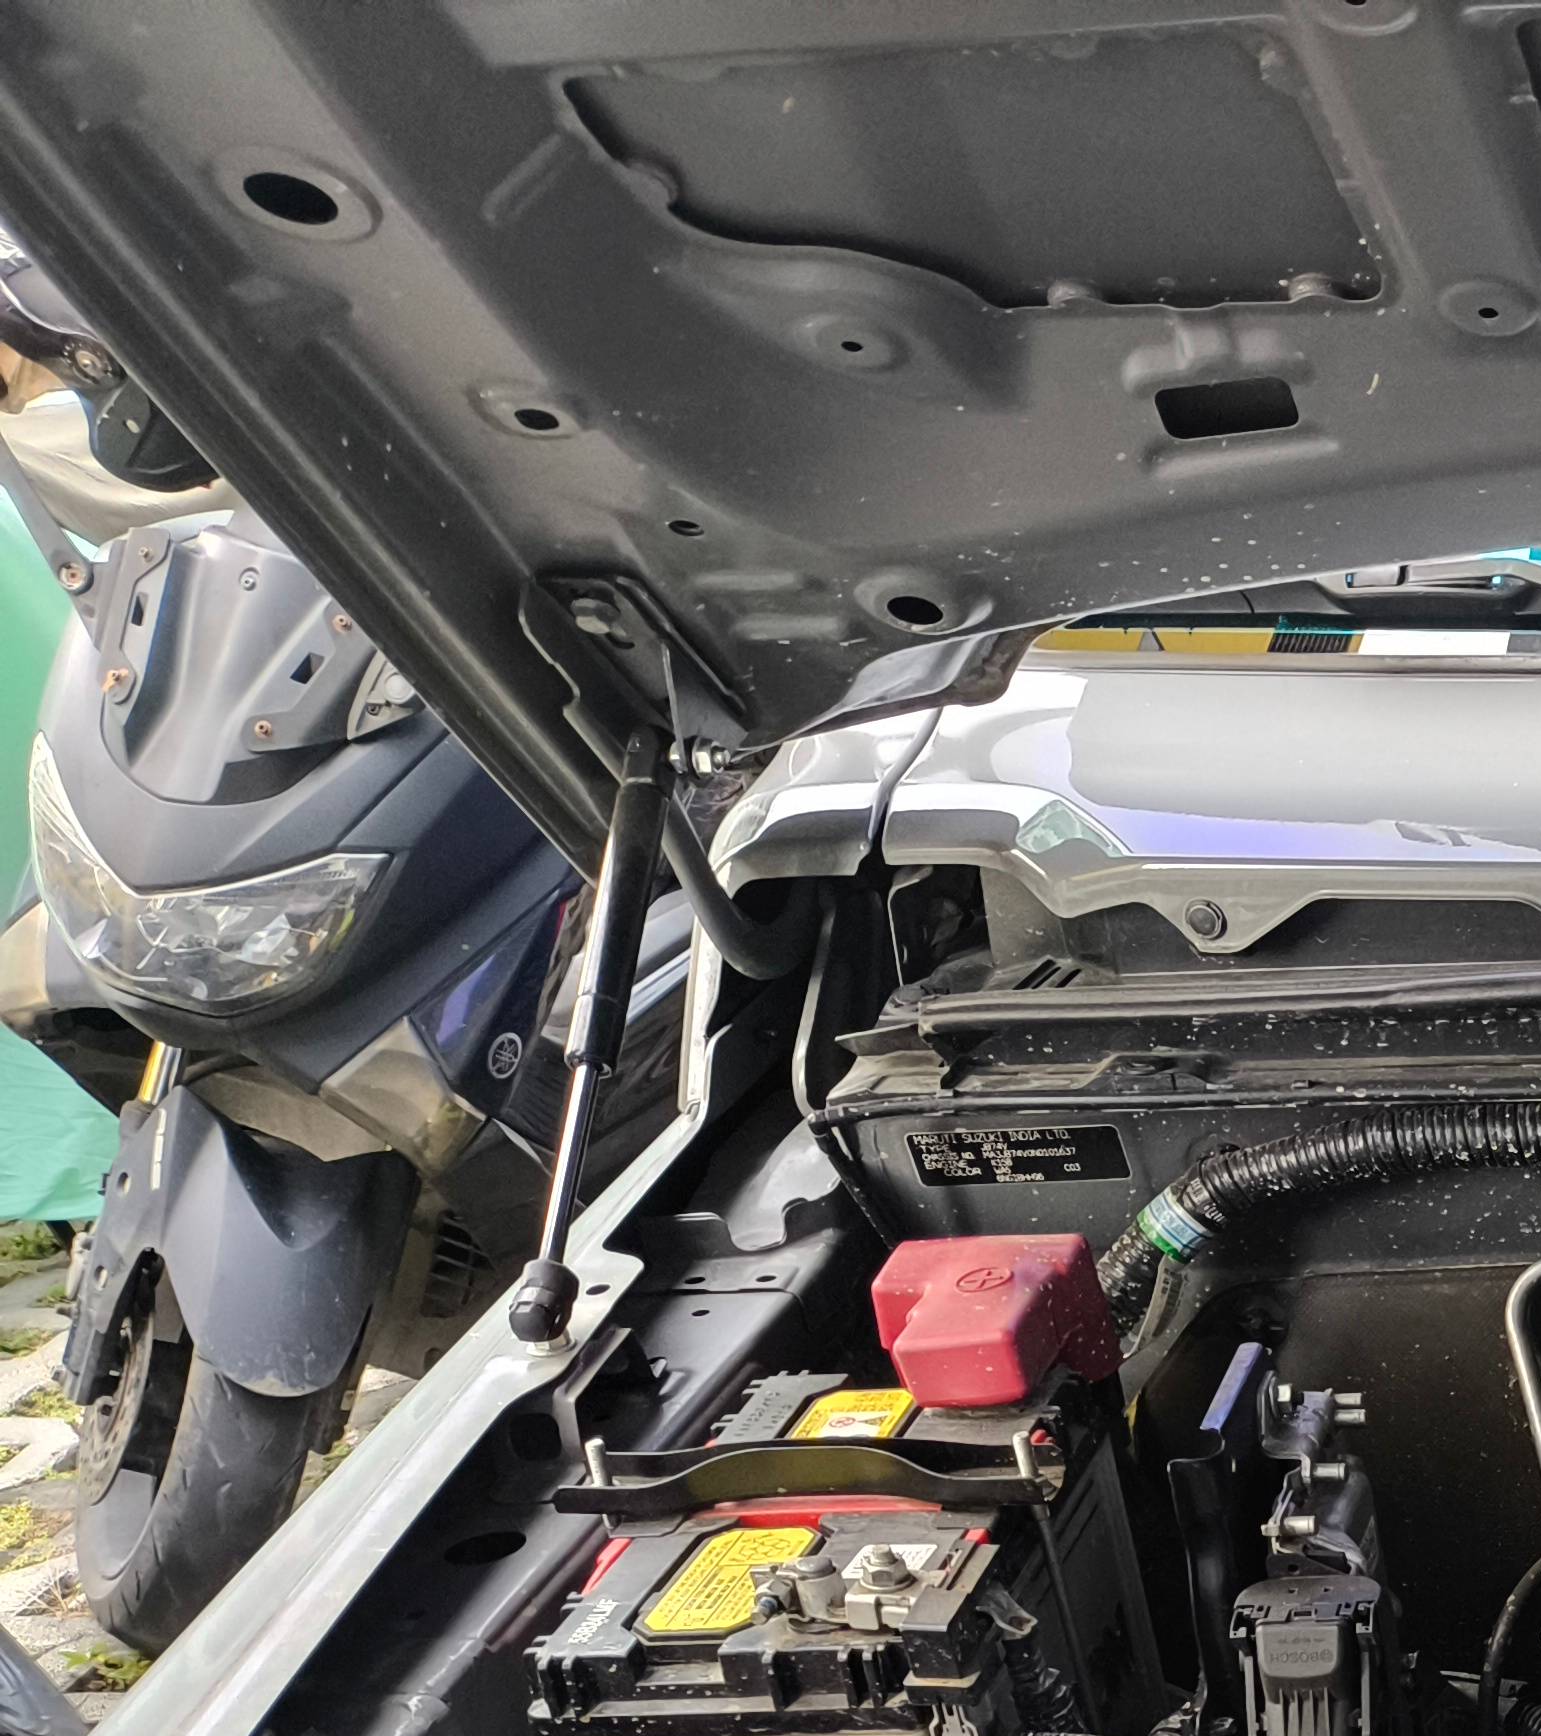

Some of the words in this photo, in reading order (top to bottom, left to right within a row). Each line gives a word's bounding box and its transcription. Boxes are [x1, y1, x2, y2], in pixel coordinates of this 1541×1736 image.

[912, 1133, 957, 1145] MARUTI
[961, 1131, 1003, 1143] SUZUKI
[1008, 1130, 1042, 1141] INDIA
[924, 1159, 968, 1170] ENGINE
[943, 1167, 982, 1176] COLOR
